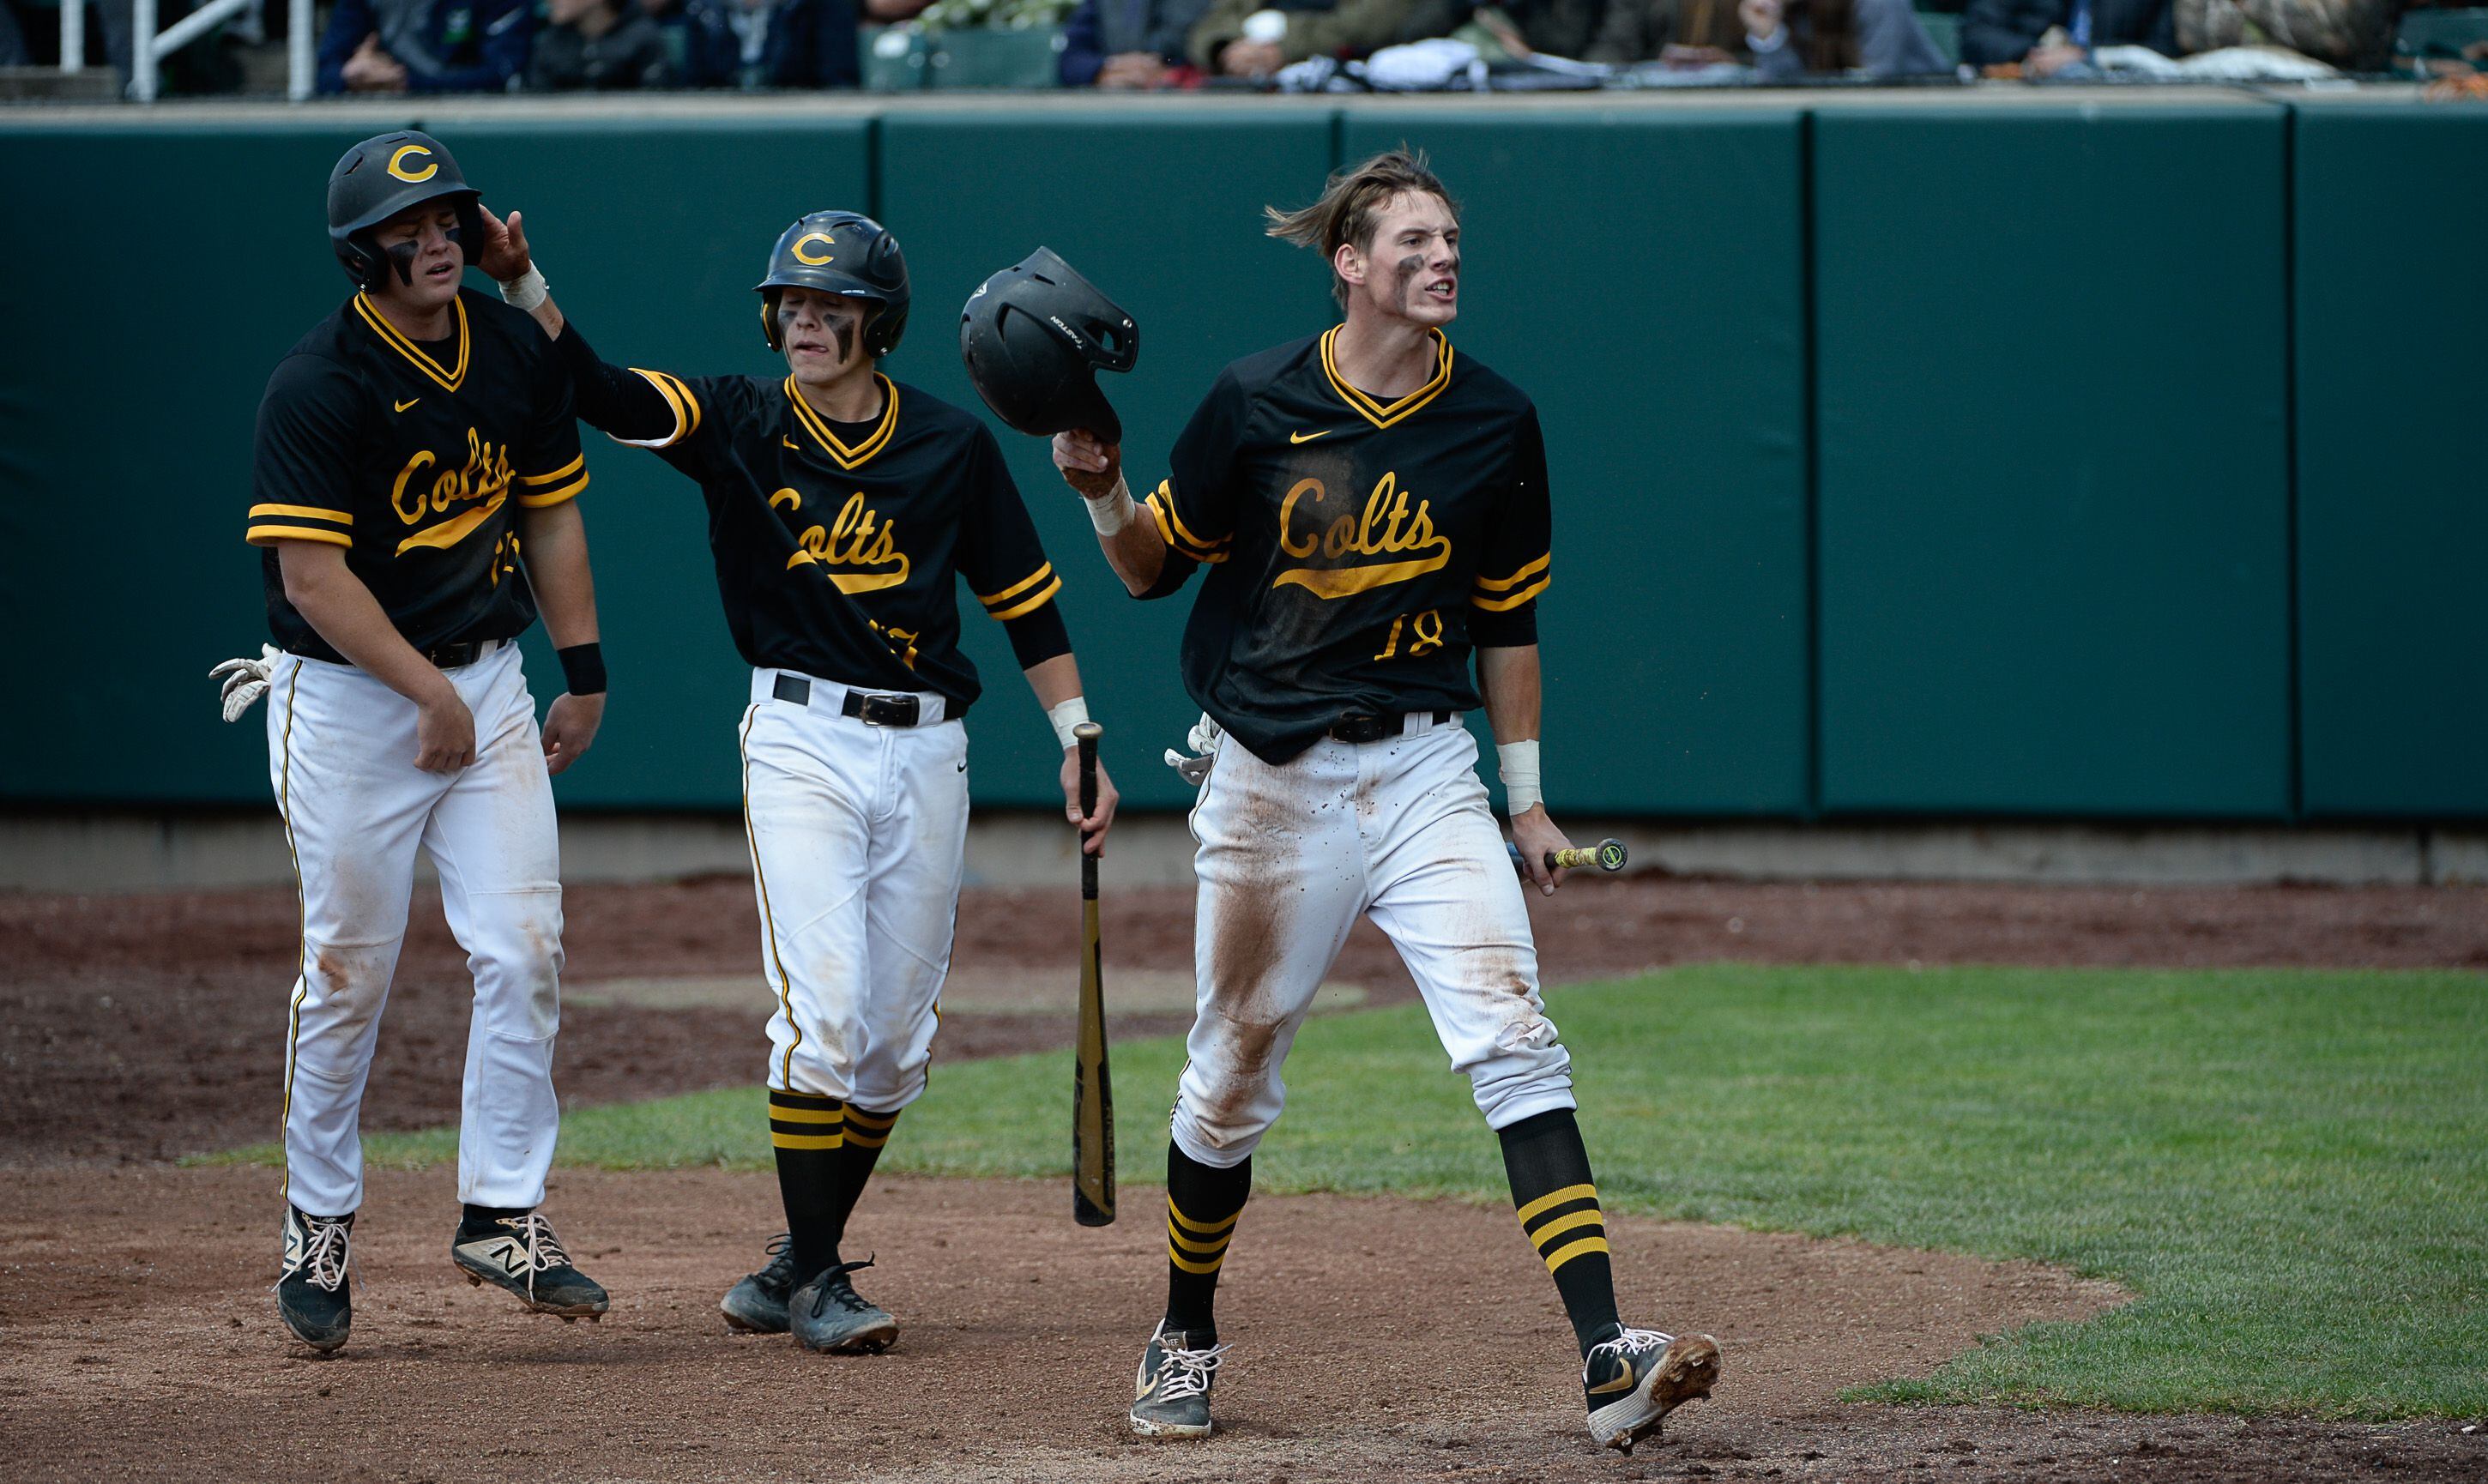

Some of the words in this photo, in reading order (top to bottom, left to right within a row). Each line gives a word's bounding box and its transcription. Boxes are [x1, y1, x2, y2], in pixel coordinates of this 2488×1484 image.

[387, 144, 438, 184] C
[791, 232, 836, 267] C
[391, 426, 517, 525] Colts
[1278, 470, 1443, 560] Colts
[1374, 609, 1445, 662] 18
[491, 1244, 528, 1276] N
